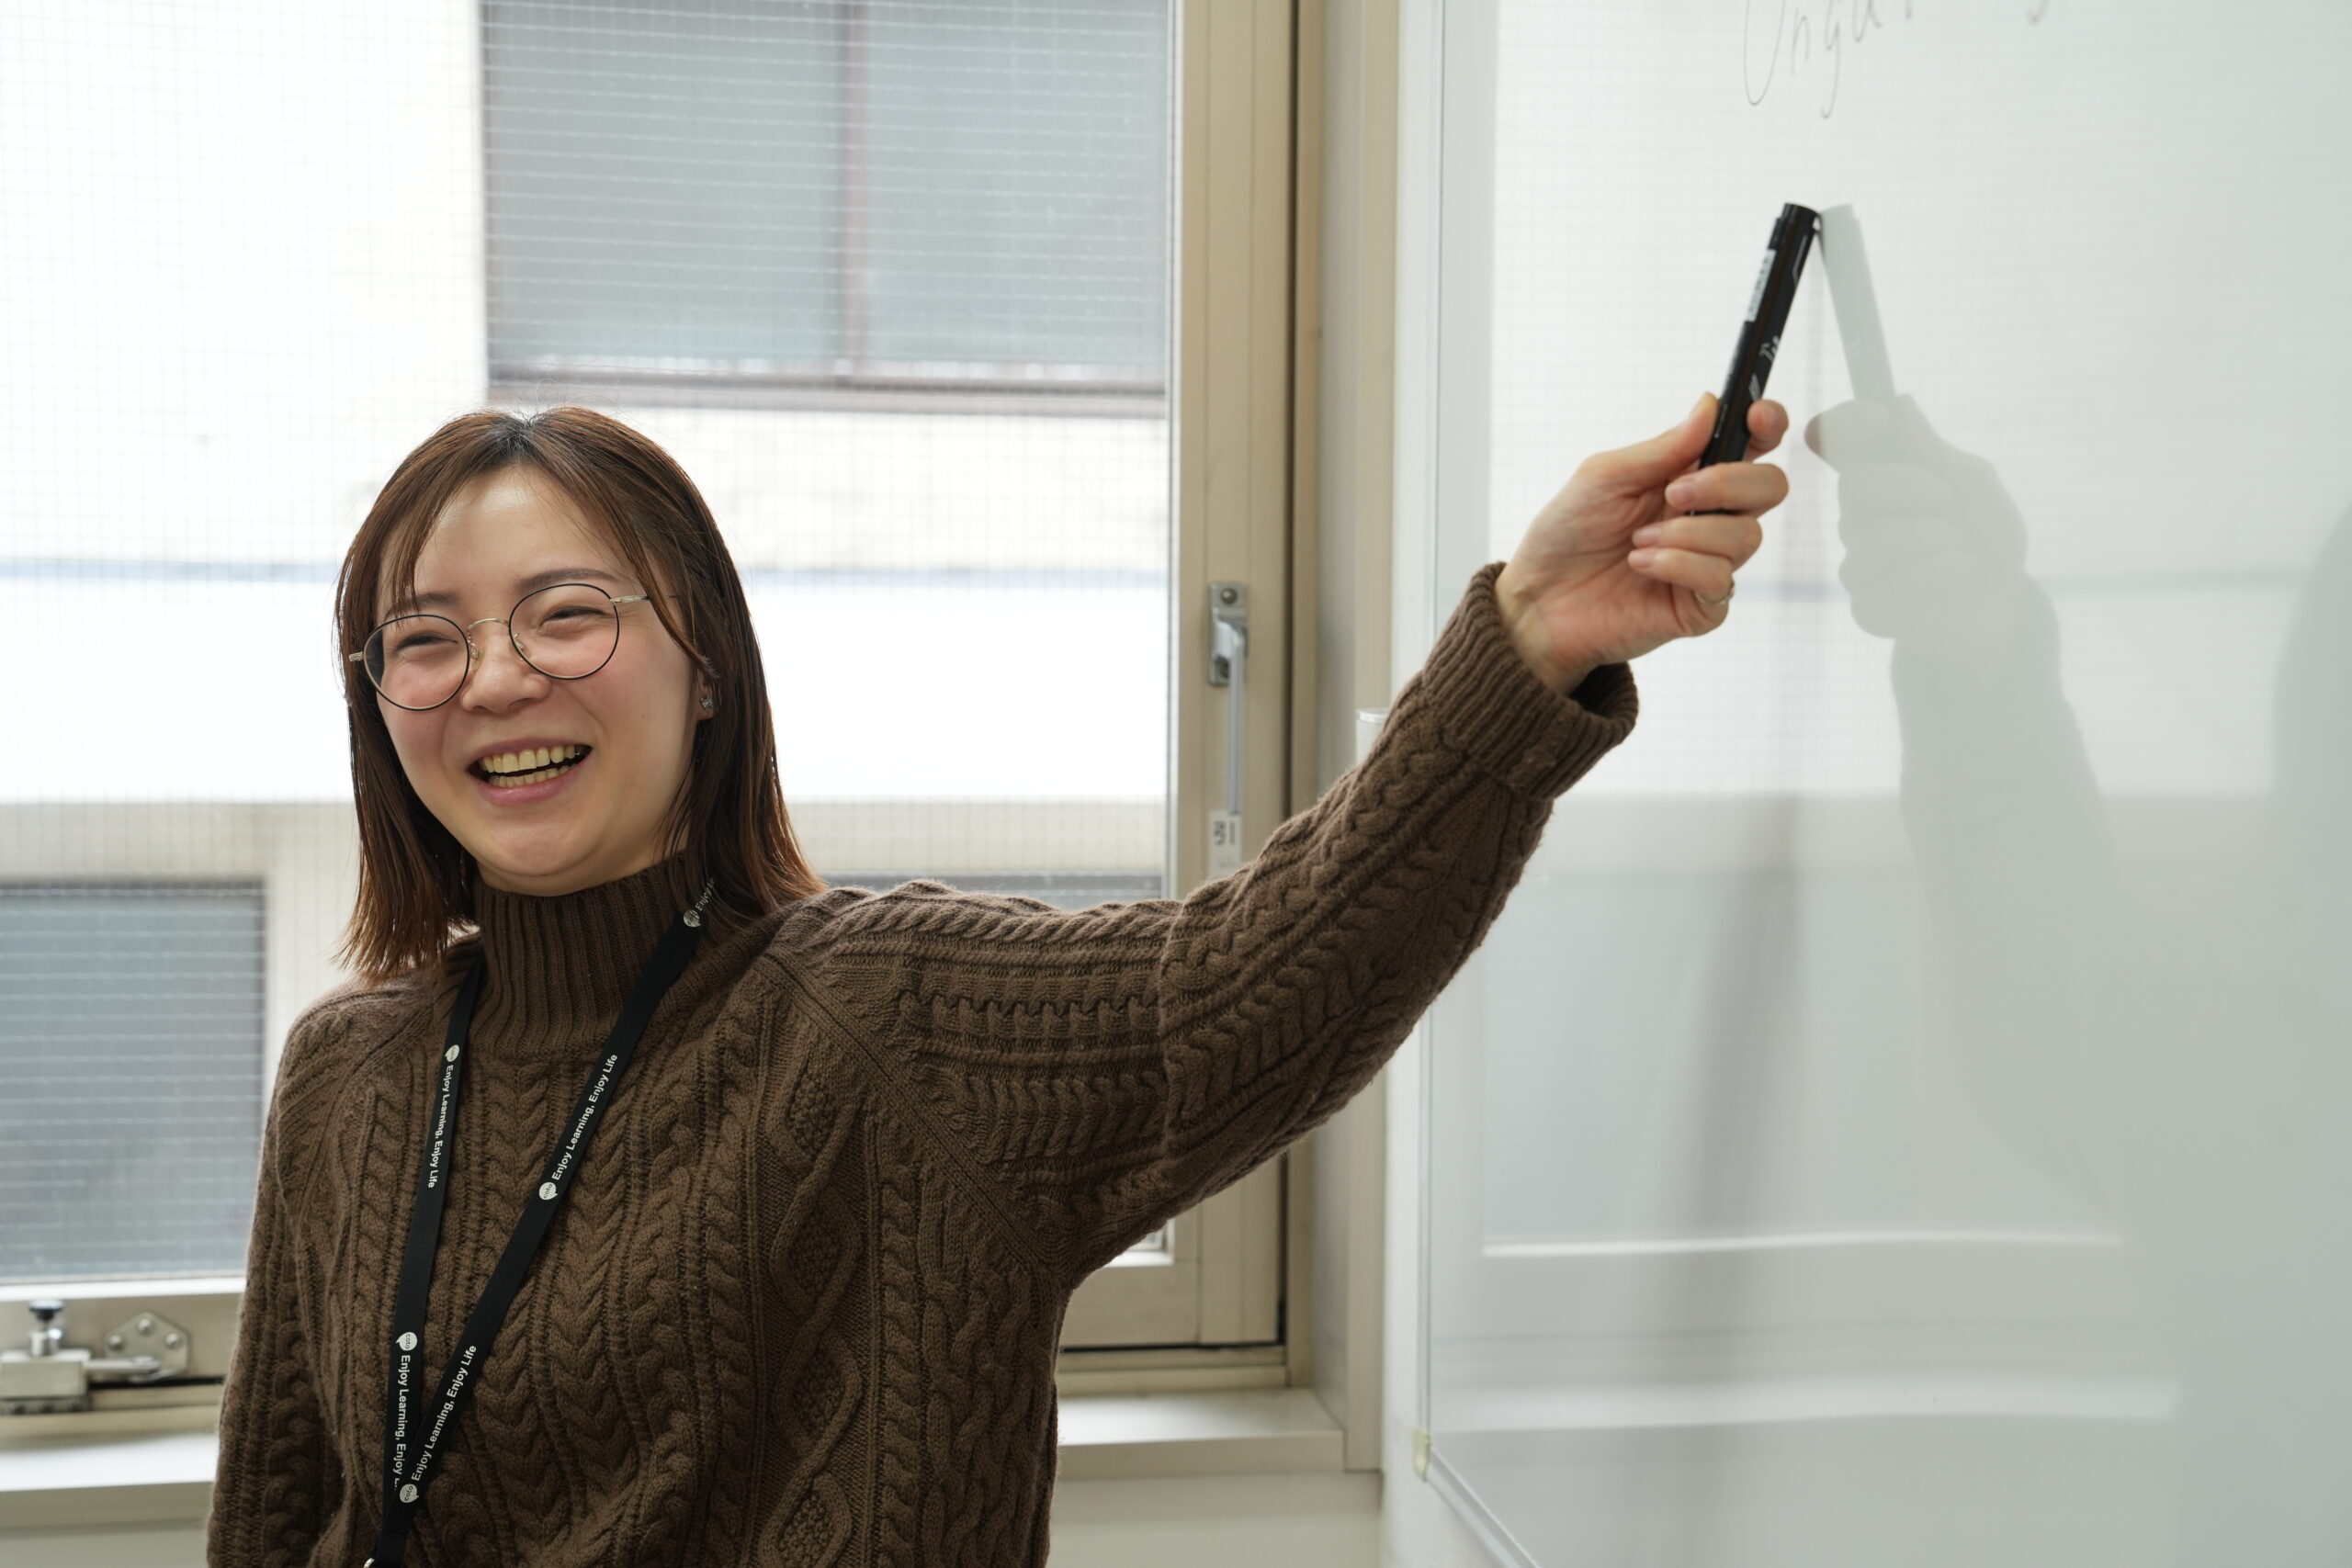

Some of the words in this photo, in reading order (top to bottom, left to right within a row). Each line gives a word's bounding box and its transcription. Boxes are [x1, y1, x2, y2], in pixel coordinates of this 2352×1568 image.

[442, 1065, 454, 1092] Enjoy
[435, 1094, 450, 1139] Learning,
[551, 1151, 572, 1181] Enjoy
[566, 1105, 595, 1151] Learning,
[588, 1074, 609, 1103] Enjoy
[603, 1055, 617, 1074] Life
[429, 1140, 443, 1168] Enjoy
[427, 1169, 439, 1189] Life
[398, 1354, 411, 1386] Enjoy
[394, 1388, 409, 1440] Learning,
[411, 1450, 432, 1482] Enjoy
[424, 1401, 455, 1450] Learning,
[447, 1366, 469, 1398] Enjoy
[460, 1345, 477, 1366] Life
[392, 1443, 407, 1475] Enjoy
